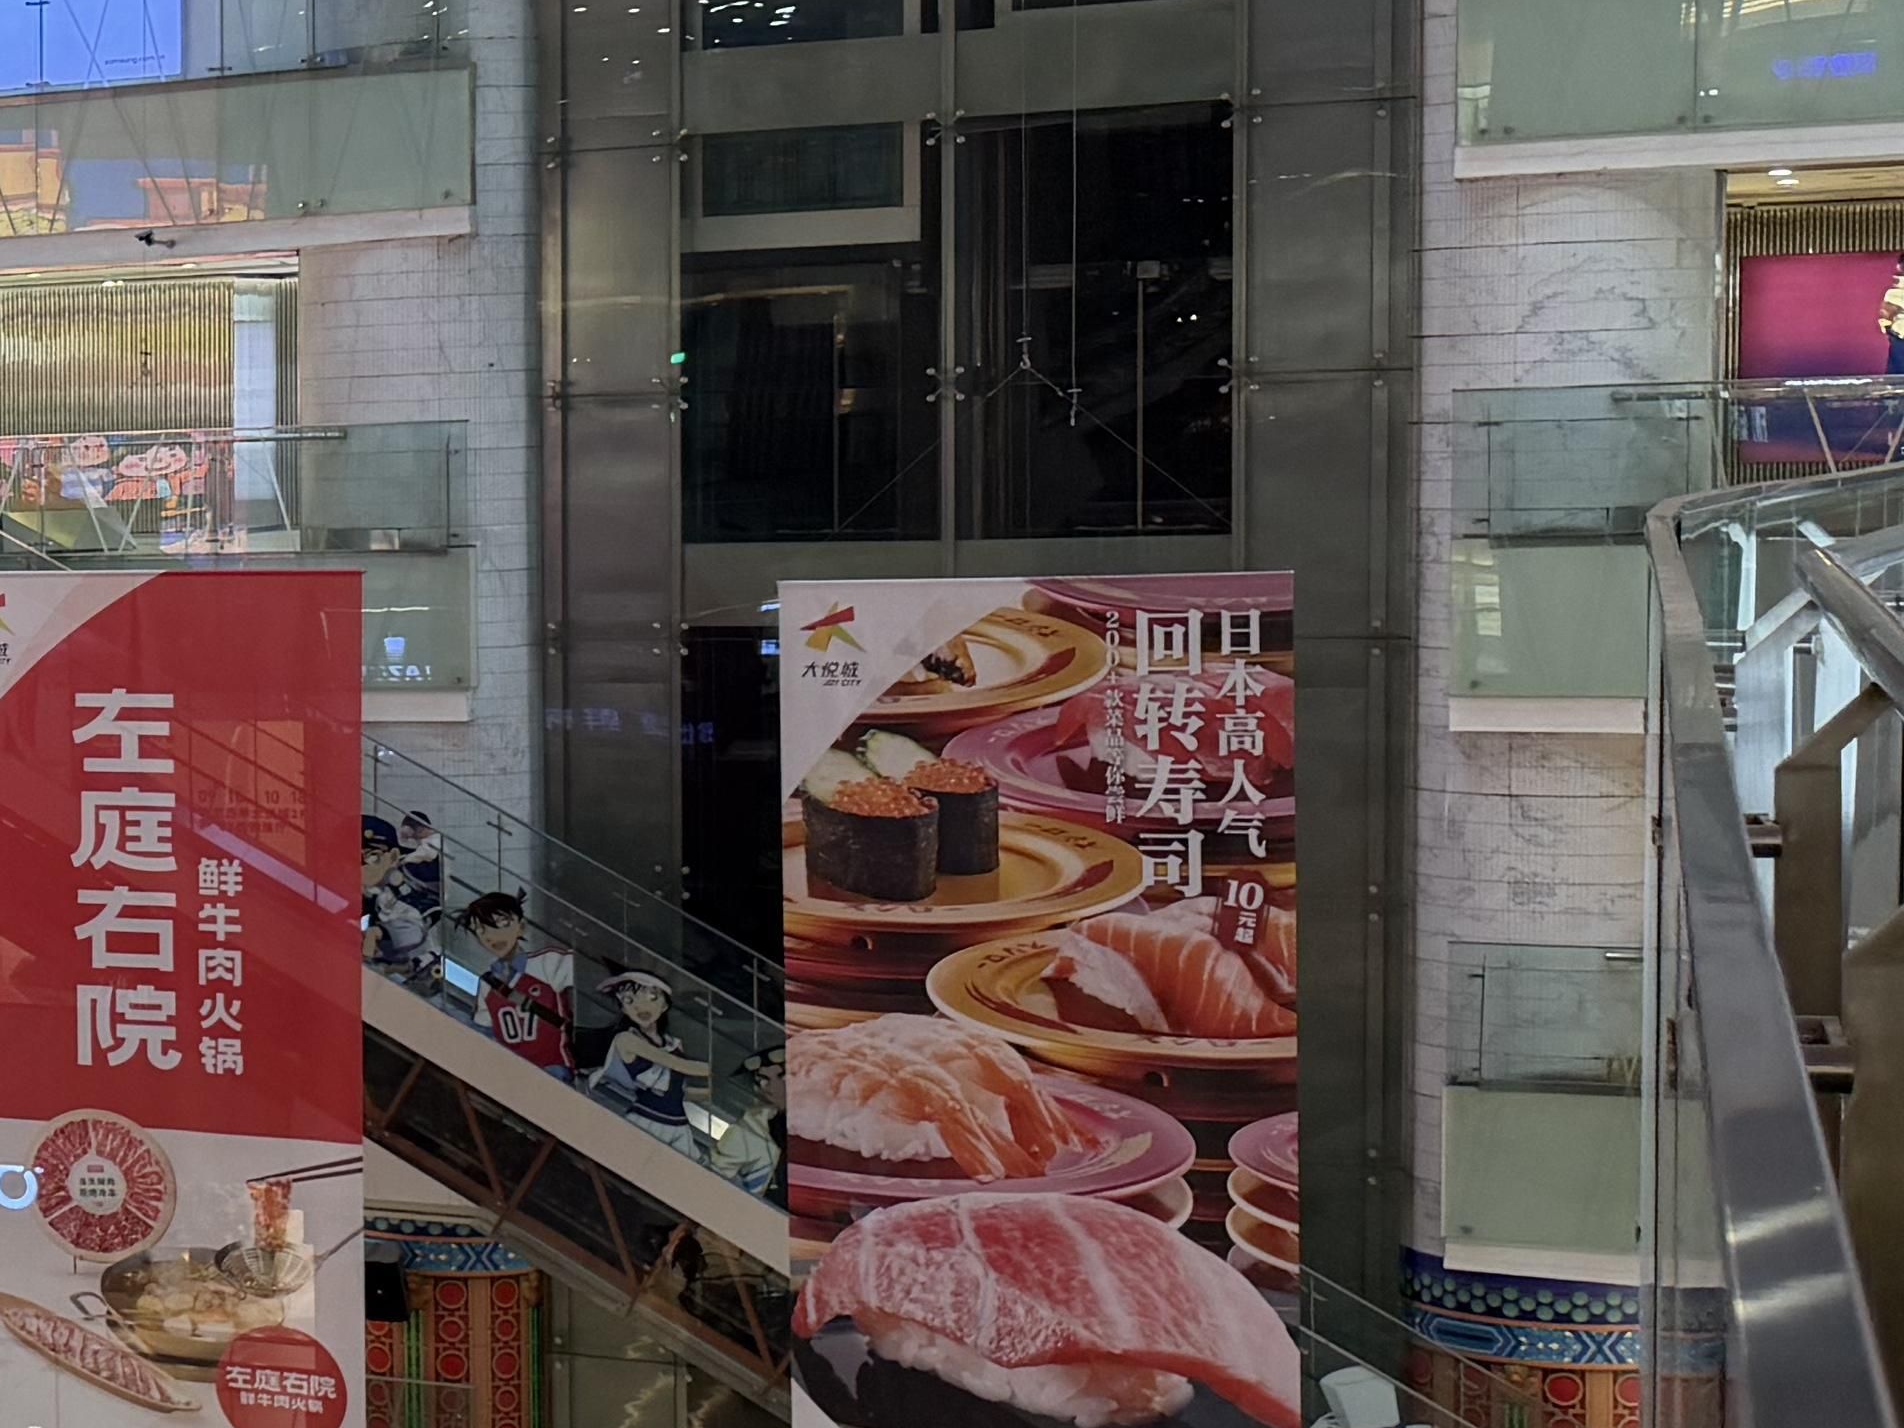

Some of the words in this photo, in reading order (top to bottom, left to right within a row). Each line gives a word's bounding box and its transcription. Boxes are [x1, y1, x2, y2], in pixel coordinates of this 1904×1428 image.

[801, 659, 860, 680] 大悦城
[1133, 607, 1207, 899] 回转寿司
[1216, 607, 1267, 859] 日本高人气
[70, 687, 183, 1071] 左庭右院
[197, 857, 245, 1077] 鲜牛肉火锅
[497, 1003, 540, 1046] 07
[225, 1365, 337, 1400] 左庭右院
